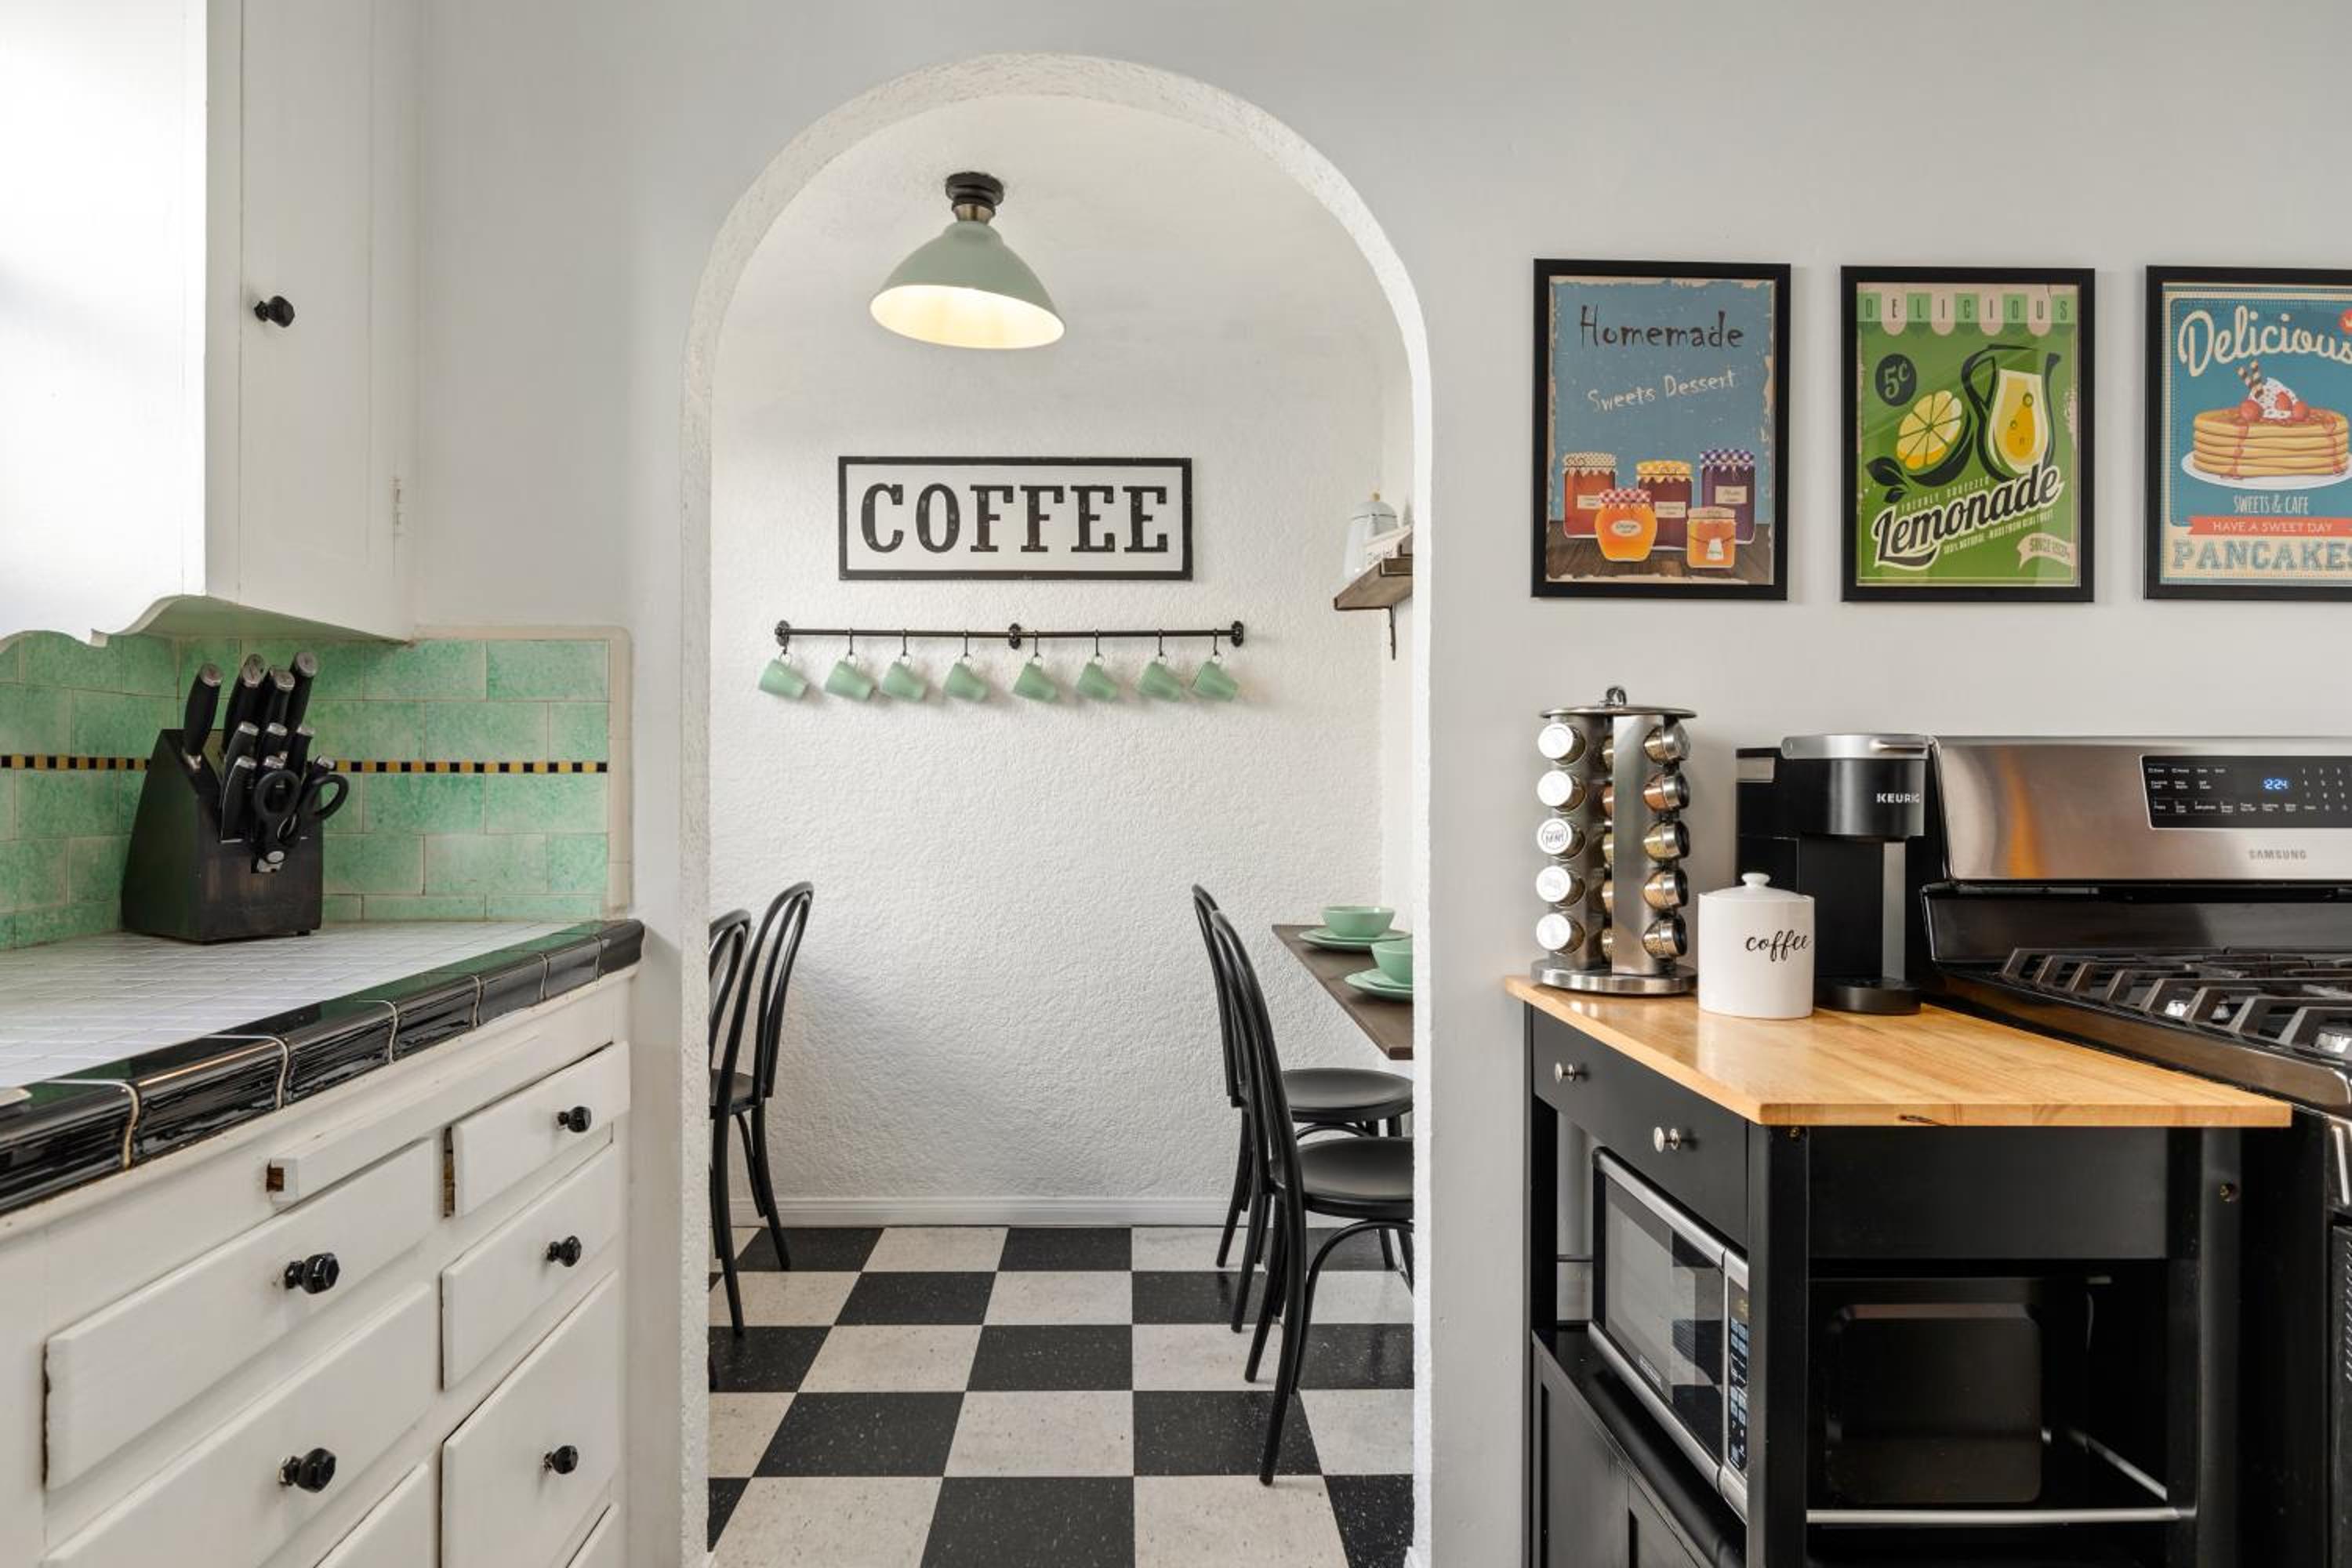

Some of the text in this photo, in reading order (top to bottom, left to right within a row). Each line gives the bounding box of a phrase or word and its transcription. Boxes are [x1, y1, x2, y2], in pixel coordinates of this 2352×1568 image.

[1865, 297, 2068, 321] DELICIOUS
[1581, 303, 1744, 349] Homemade
[1587, 368, 1736, 412] Sweets Dessert
[862, 483, 1169, 553] COFFEE
[1872, 465, 2064, 566] Lemonade
[2234, 494, 2309, 515] SWEETS & CAFE
[2213, 521, 2333, 533] HAVE A SWEET DAY
[2249, 849, 2307, 861] SAMSUNG
[1745, 930, 1809, 962] coffee
